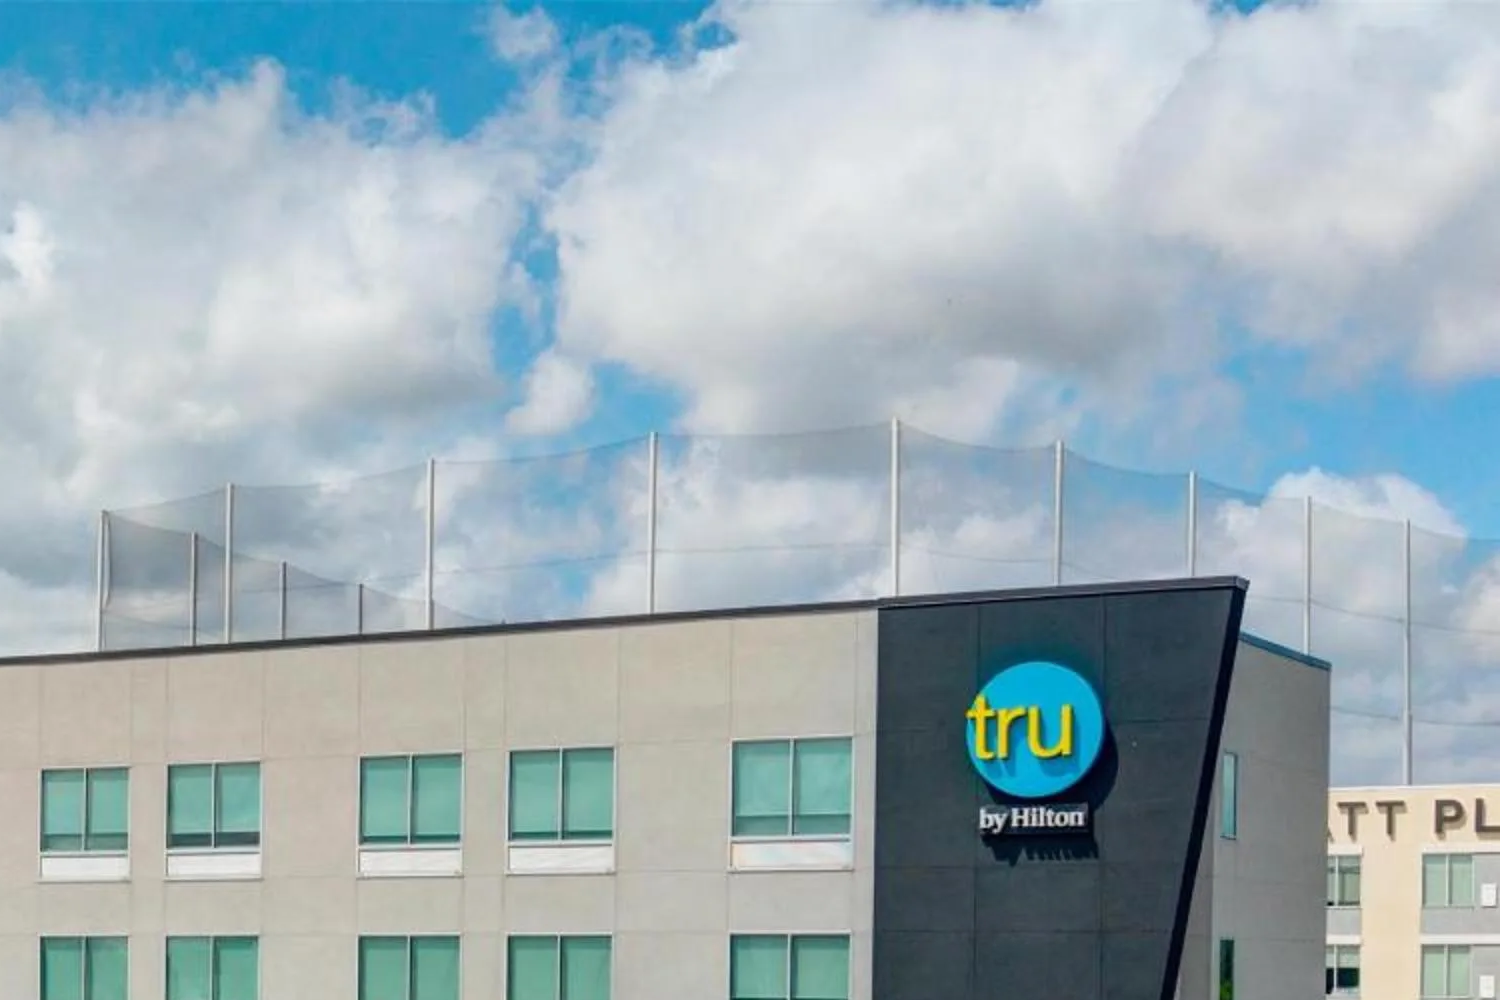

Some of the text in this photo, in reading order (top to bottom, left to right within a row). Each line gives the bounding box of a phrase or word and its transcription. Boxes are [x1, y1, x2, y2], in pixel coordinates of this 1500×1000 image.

[965, 694, 1072, 760] tru
[979, 807, 1084, 834] by Hilton
[1329, 801, 1406, 838] TT
